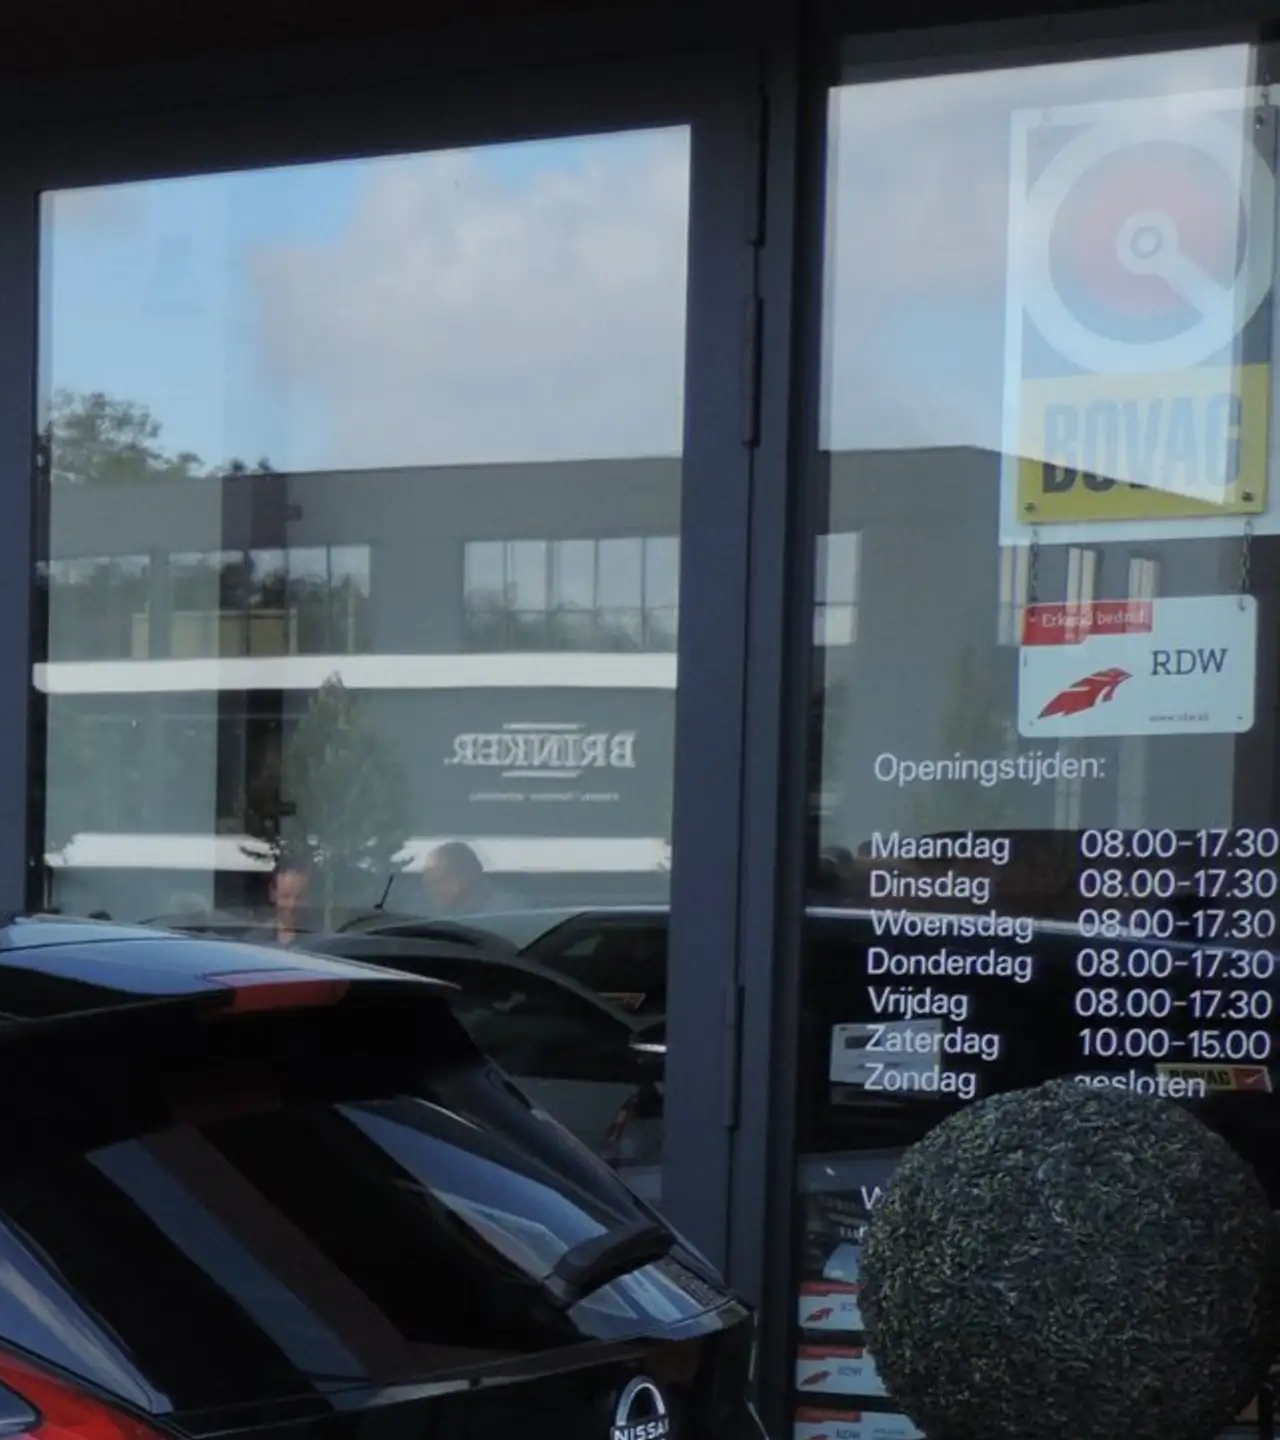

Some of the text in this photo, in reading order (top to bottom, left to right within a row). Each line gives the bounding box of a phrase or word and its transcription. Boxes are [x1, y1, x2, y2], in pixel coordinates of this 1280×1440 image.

[1043, 392, 1242, 493] BOVAG
[1149, 648, 1229, 676] RDW
[873, 750, 1107, 788] Openingstijden:
[870, 828, 1279, 866] Maandag 08.00-17.30
[869, 868, 1278, 905] Dinsdag 08.00-17.30
[870, 908, 1277, 944] Woensdag 08.00-17.30
[867, 948, 1275, 984] Donderdag 08.00-17.30
[867, 986, 1273, 1022] Vrijdag 08.00-17.30
[864, 1024, 1272, 1062] Zaterdag 10.00-15.00
[863, 1062, 977, 1100] Zondag
